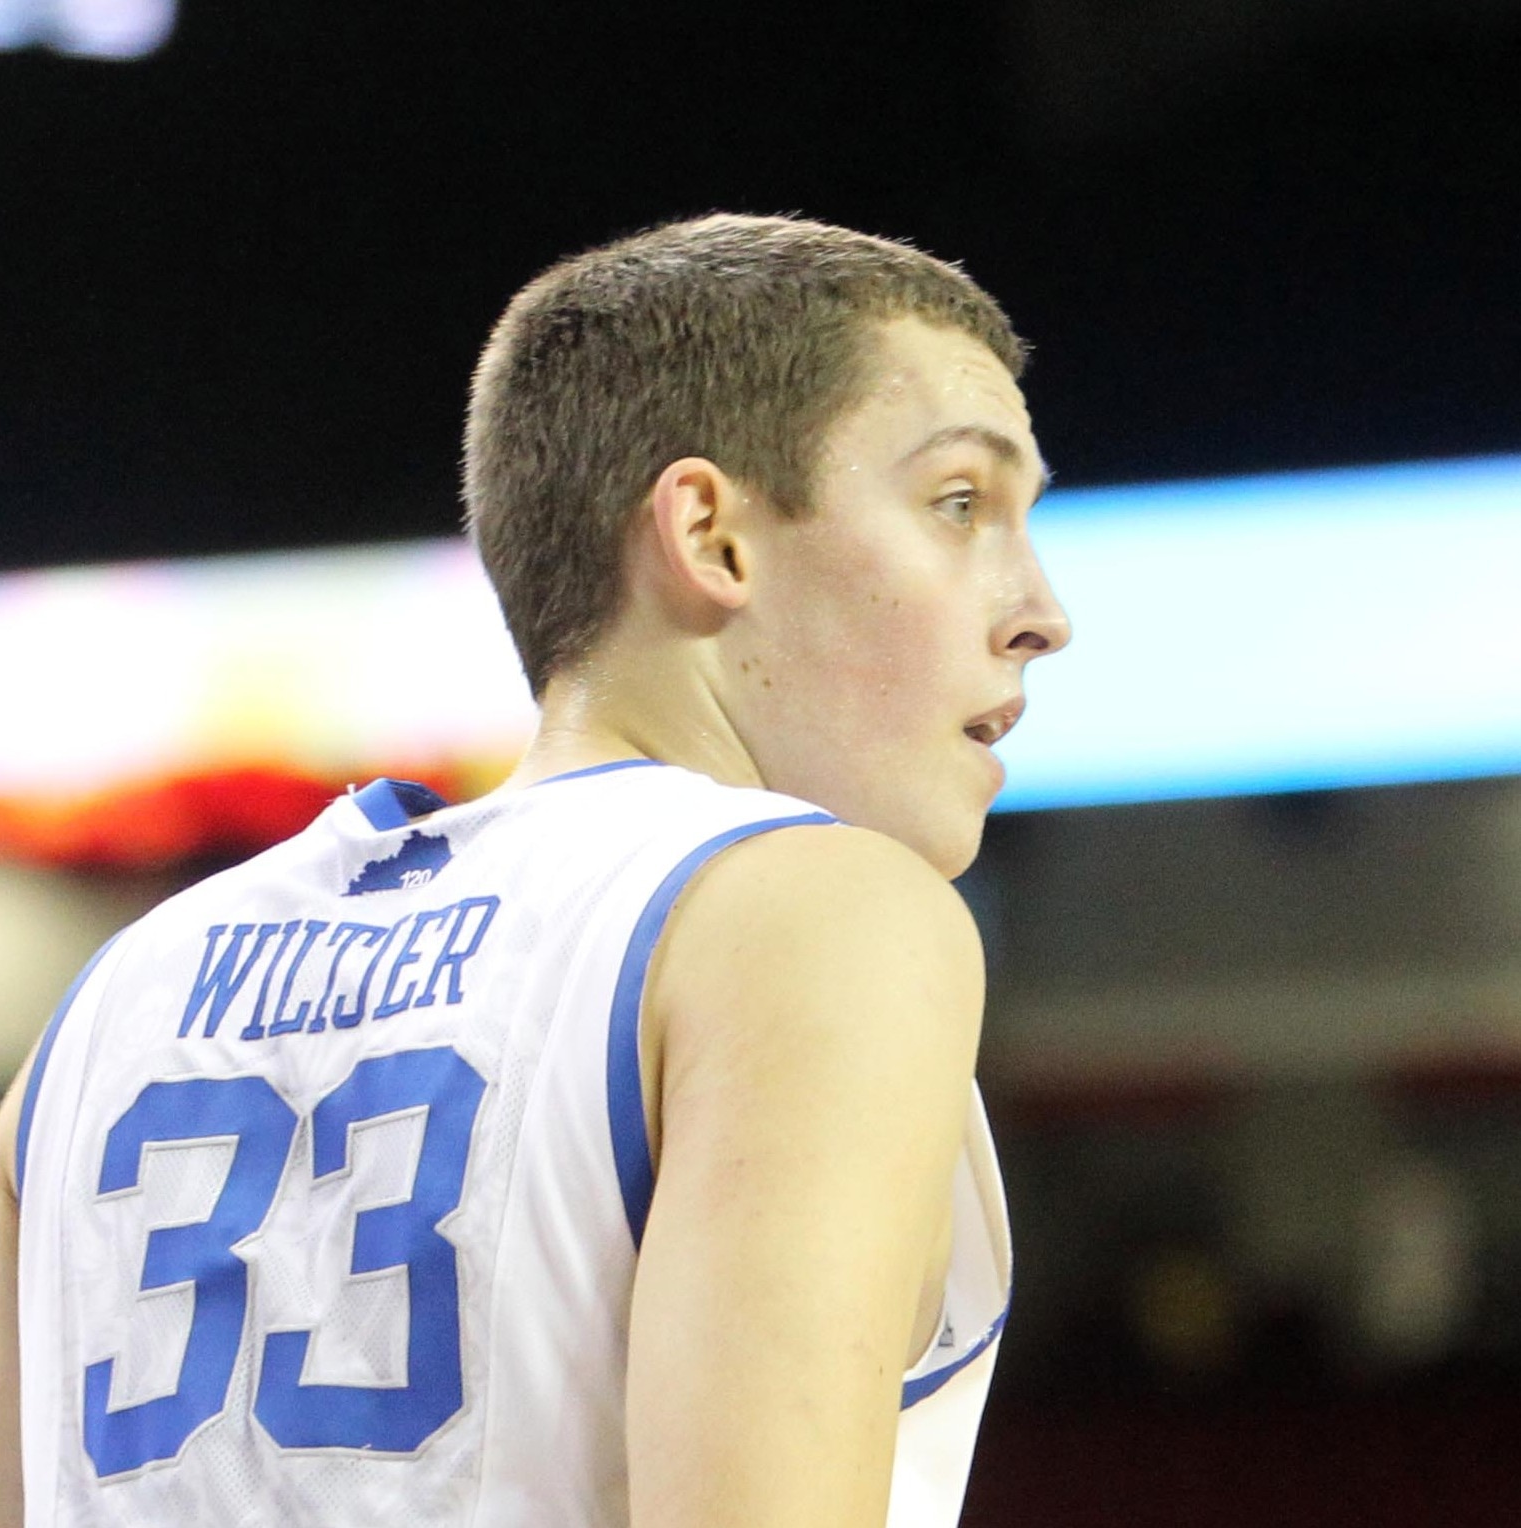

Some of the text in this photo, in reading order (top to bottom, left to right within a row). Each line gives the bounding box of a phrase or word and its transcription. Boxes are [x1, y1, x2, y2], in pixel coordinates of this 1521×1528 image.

[400, 868, 432, 889] 120
[177, 894, 501, 1041] WILTJER
[87, 1047, 486, 1477] 33
